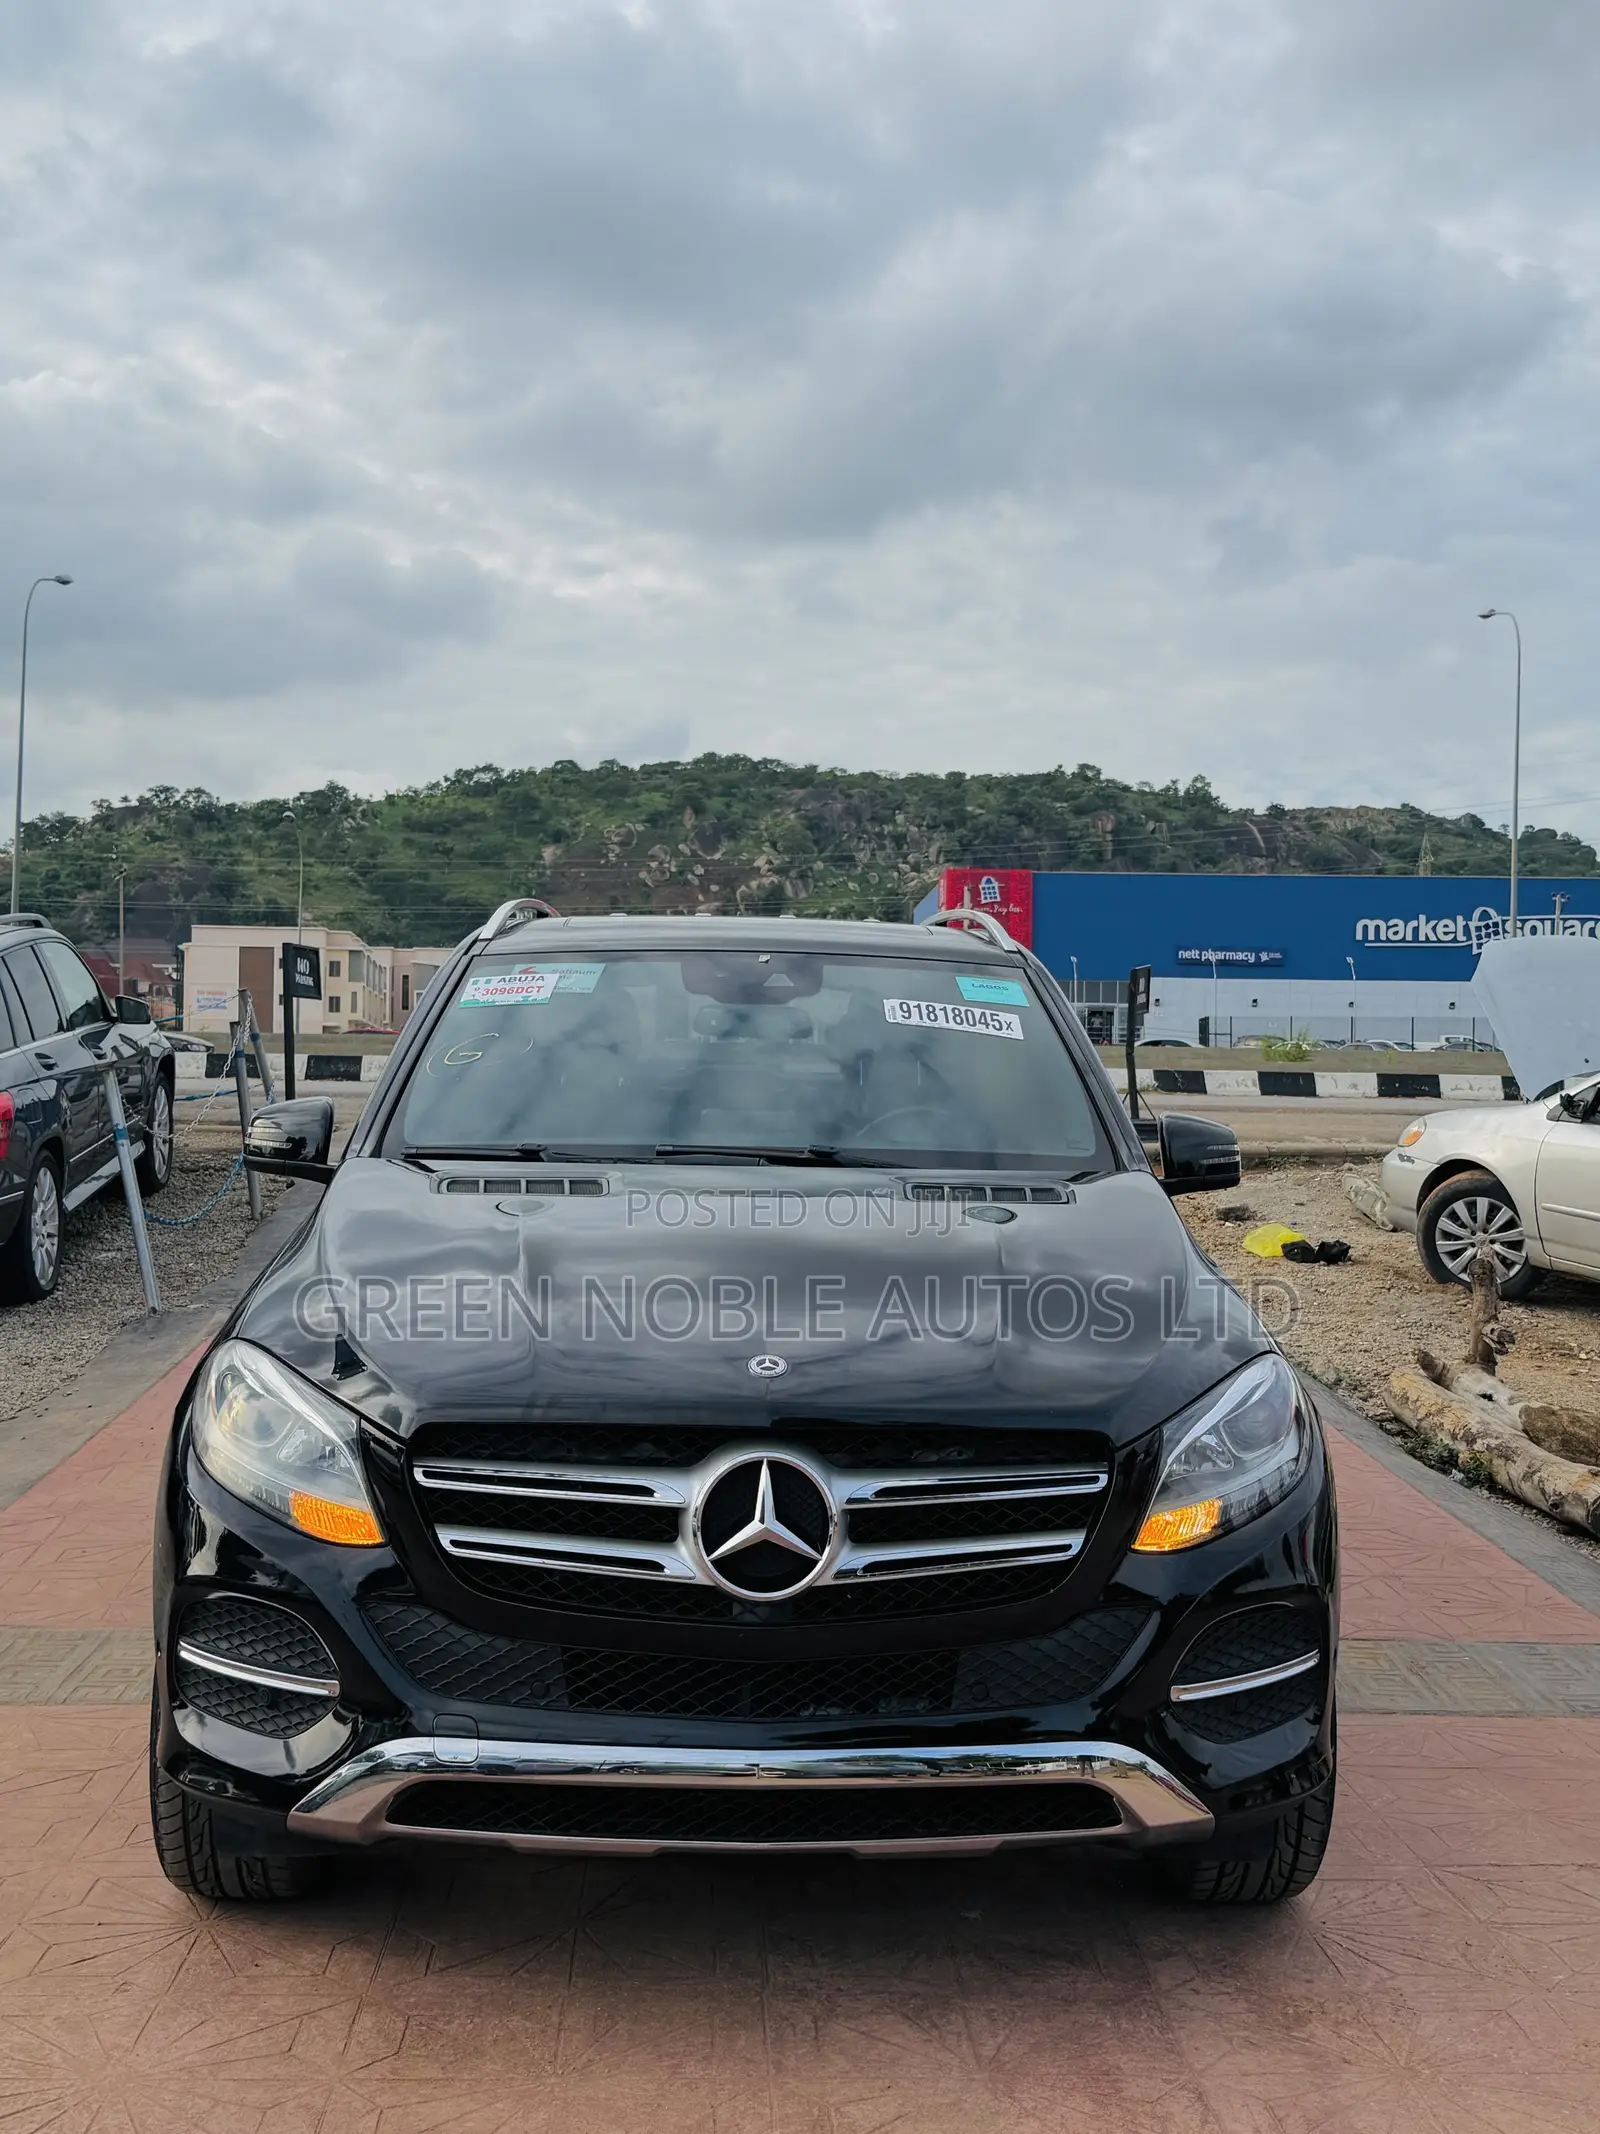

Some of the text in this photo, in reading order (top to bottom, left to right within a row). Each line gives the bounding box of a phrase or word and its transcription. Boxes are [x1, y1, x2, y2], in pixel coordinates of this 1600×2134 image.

[1356, 914, 1467, 941] market
[1178, 949, 1200, 959] nett
[1201, 949, 1255, 963] pharmacy
[297, 957, 310, 975] NO
[496, 975, 545, 984] ABUJA
[481, 985, 545, 997] 3096DCT
